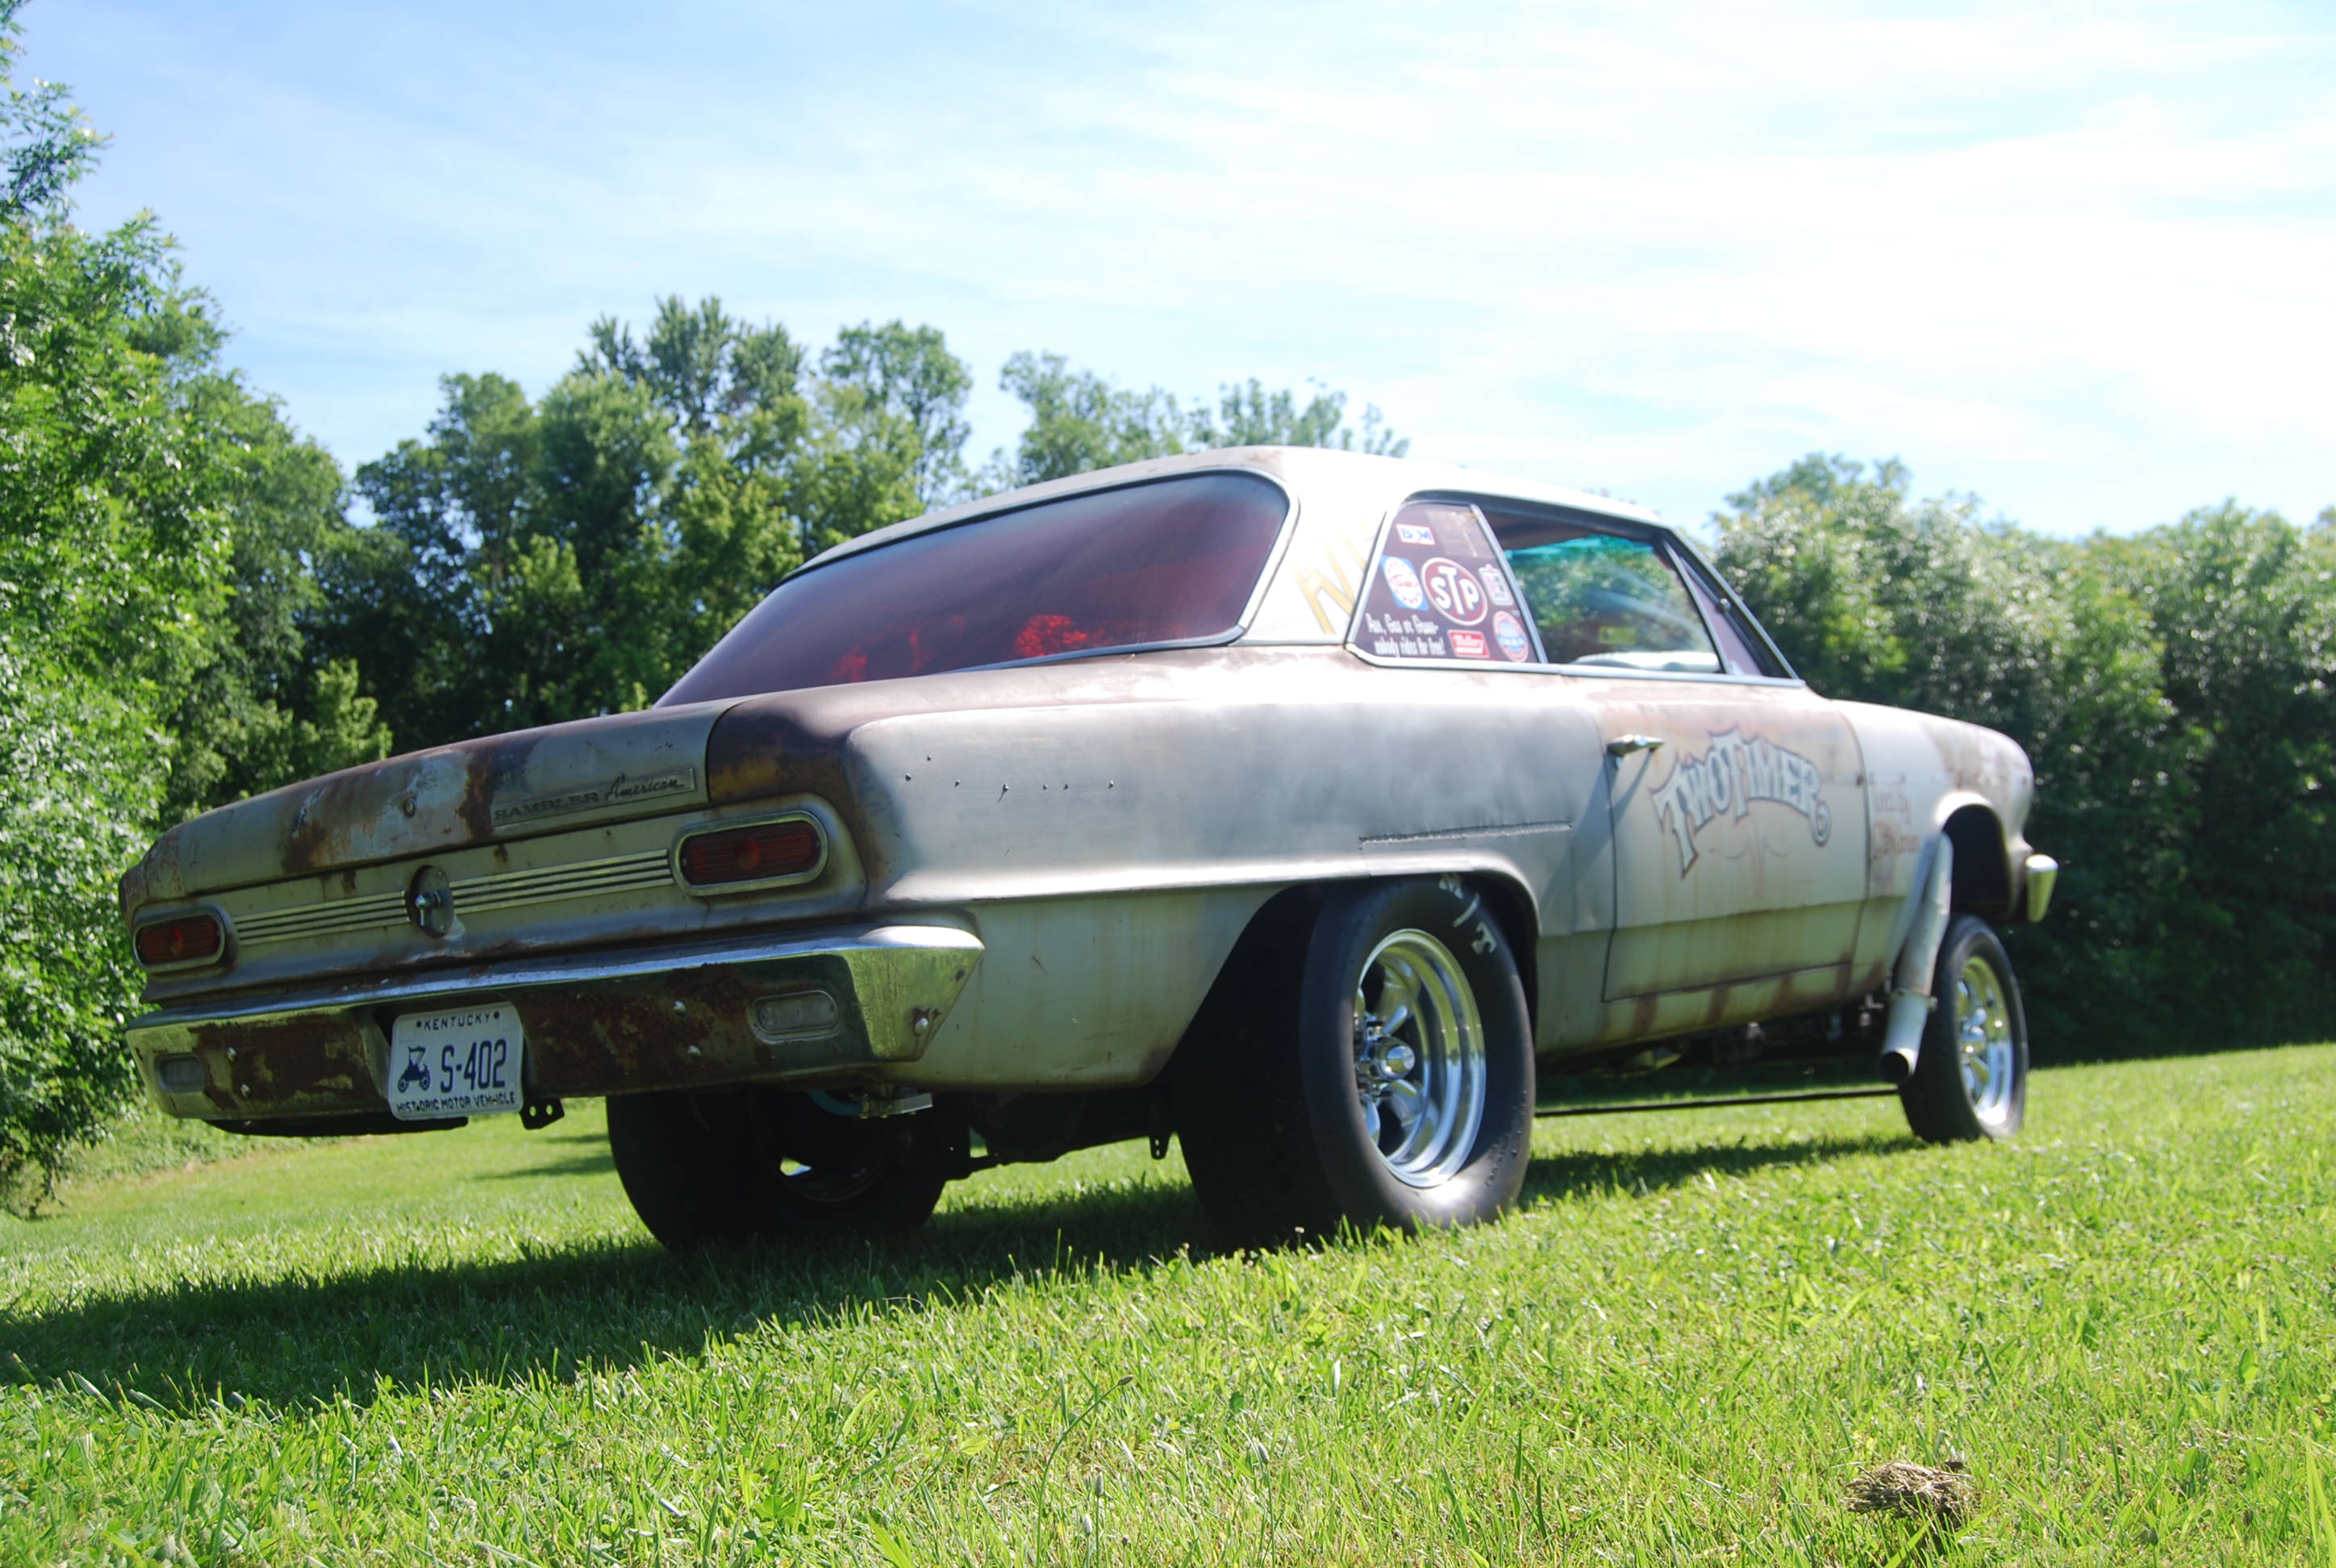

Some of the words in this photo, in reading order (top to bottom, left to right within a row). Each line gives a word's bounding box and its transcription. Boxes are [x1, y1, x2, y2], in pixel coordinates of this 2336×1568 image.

[1430, 565, 1480, 616] STP
[604, 773, 685, 801] American
[494, 792, 600, 821] RAMBLER
[424, 1013, 490, 1031] KENTUCKY
[440, 1038, 508, 1094] S-402
[396, 1098, 440, 1114] HISTORIC
[441, 1095, 472, 1111] MOTOR
[473, 1091, 516, 1110] VEHICLE
